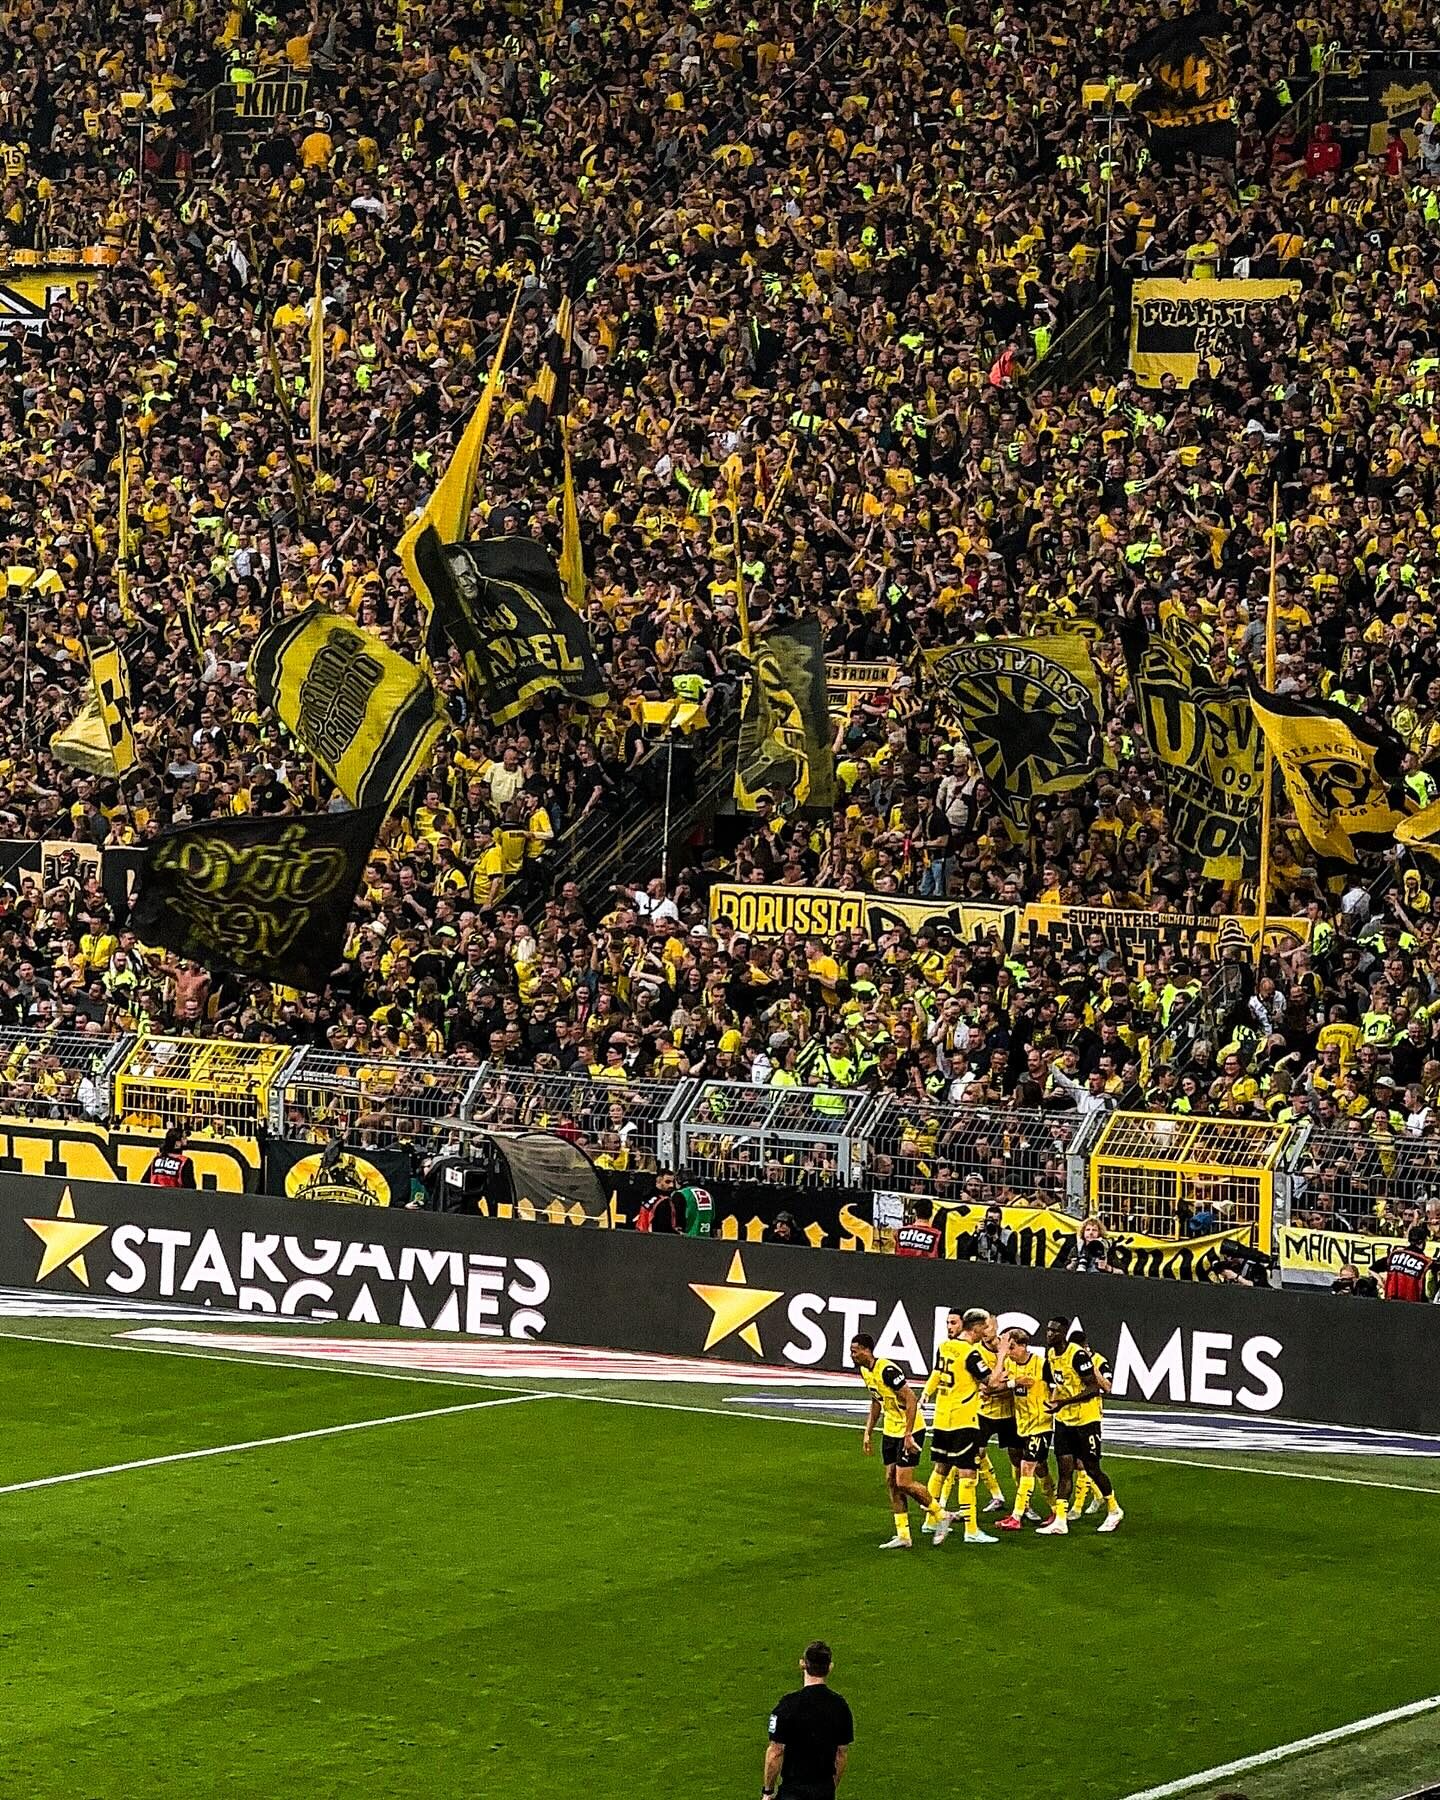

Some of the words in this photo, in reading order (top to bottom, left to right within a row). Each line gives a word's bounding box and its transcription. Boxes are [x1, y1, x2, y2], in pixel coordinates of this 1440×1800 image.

[5, 150, 21, 164] 15
[318, 653, 386, 765] ORTMUND
[719, 893, 860, 936] BORUSSIA
[700, 1223, 711, 1233] 29
[899, 1229, 935, 1244] atlas
[1285, 1233, 1406, 1265] MAINBO
[1391, 1252, 1425, 1271] atlas
[782, 1292, 1284, 1413] STAMES
[1028, 1436, 1041, 1452] 24
[1088, 1435, 1096, 1450] 9
